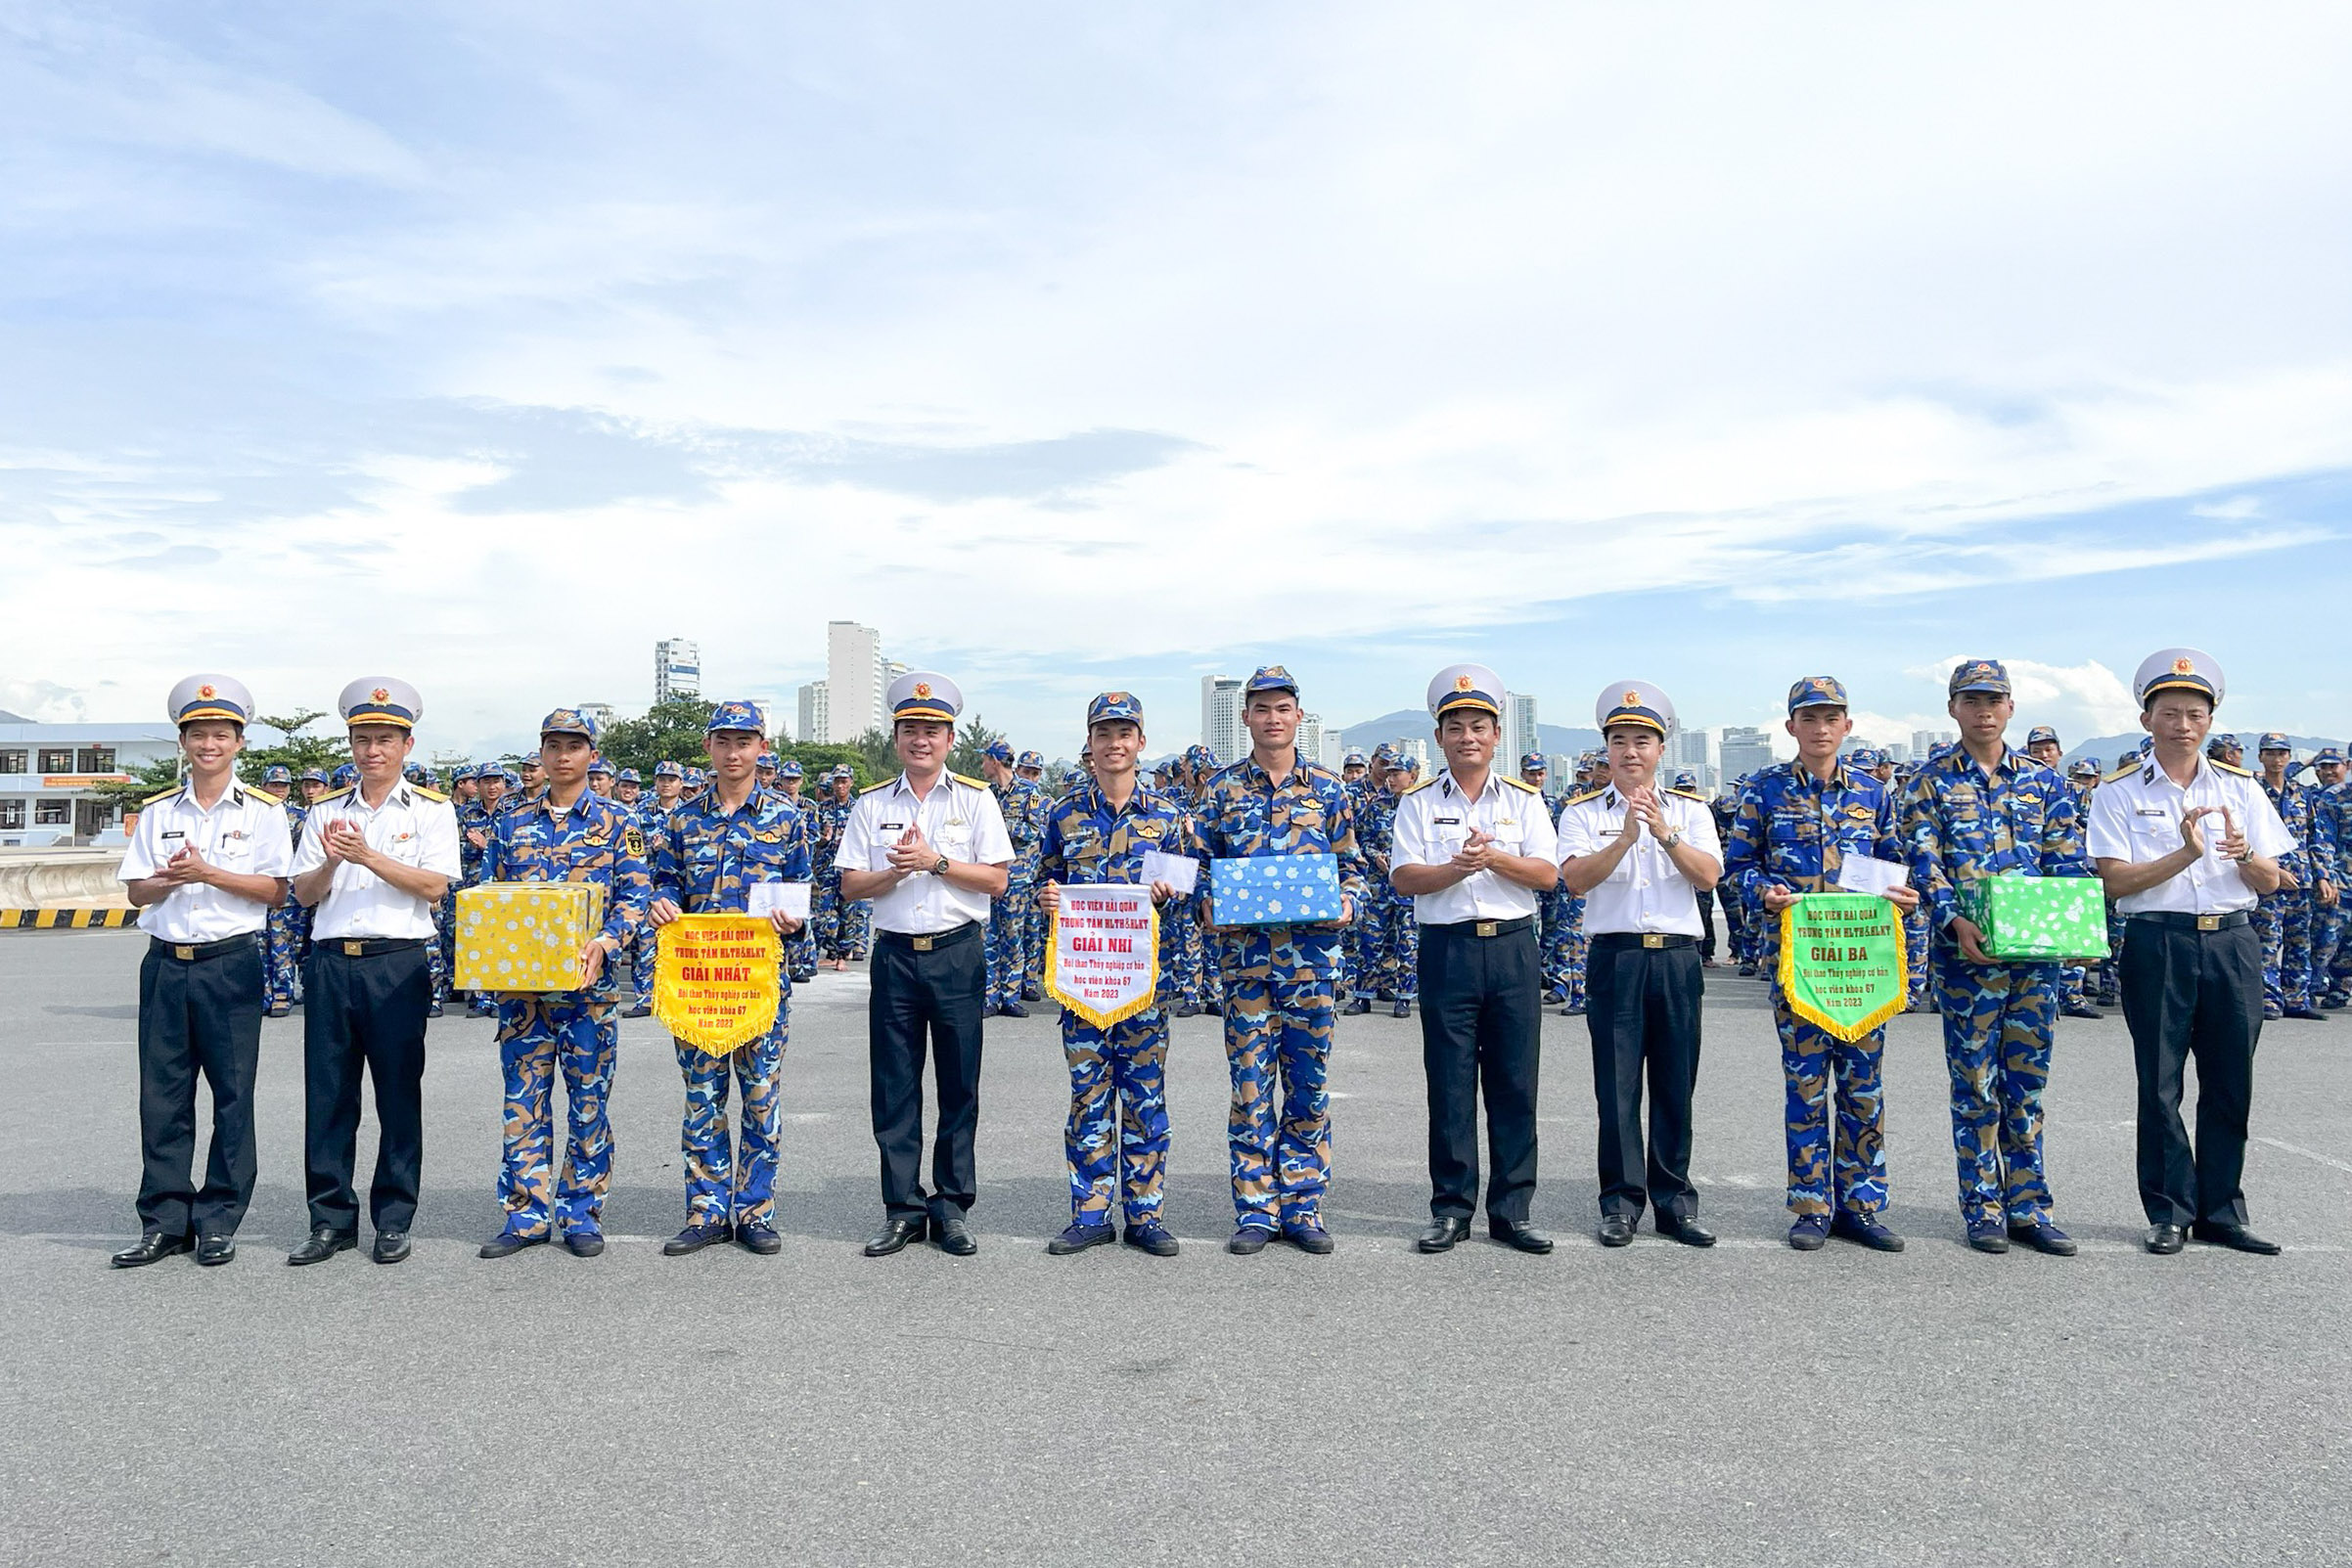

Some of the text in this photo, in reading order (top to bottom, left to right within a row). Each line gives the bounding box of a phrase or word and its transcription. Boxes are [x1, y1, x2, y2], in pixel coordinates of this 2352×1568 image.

[1061, 918, 1084, 928] TRUNG
[1797, 927, 1822, 937] TRUNG
[1073, 931, 1132, 953] GIẢI NHÌ
[675, 948, 699, 959] TRUNG
[1811, 942, 1868, 961] GIẢI BA
[683, 963, 750, 981] GIẢI NHẤT
[1865, 984, 1875, 993] 67
[1102, 989, 1118, 999] 2023
